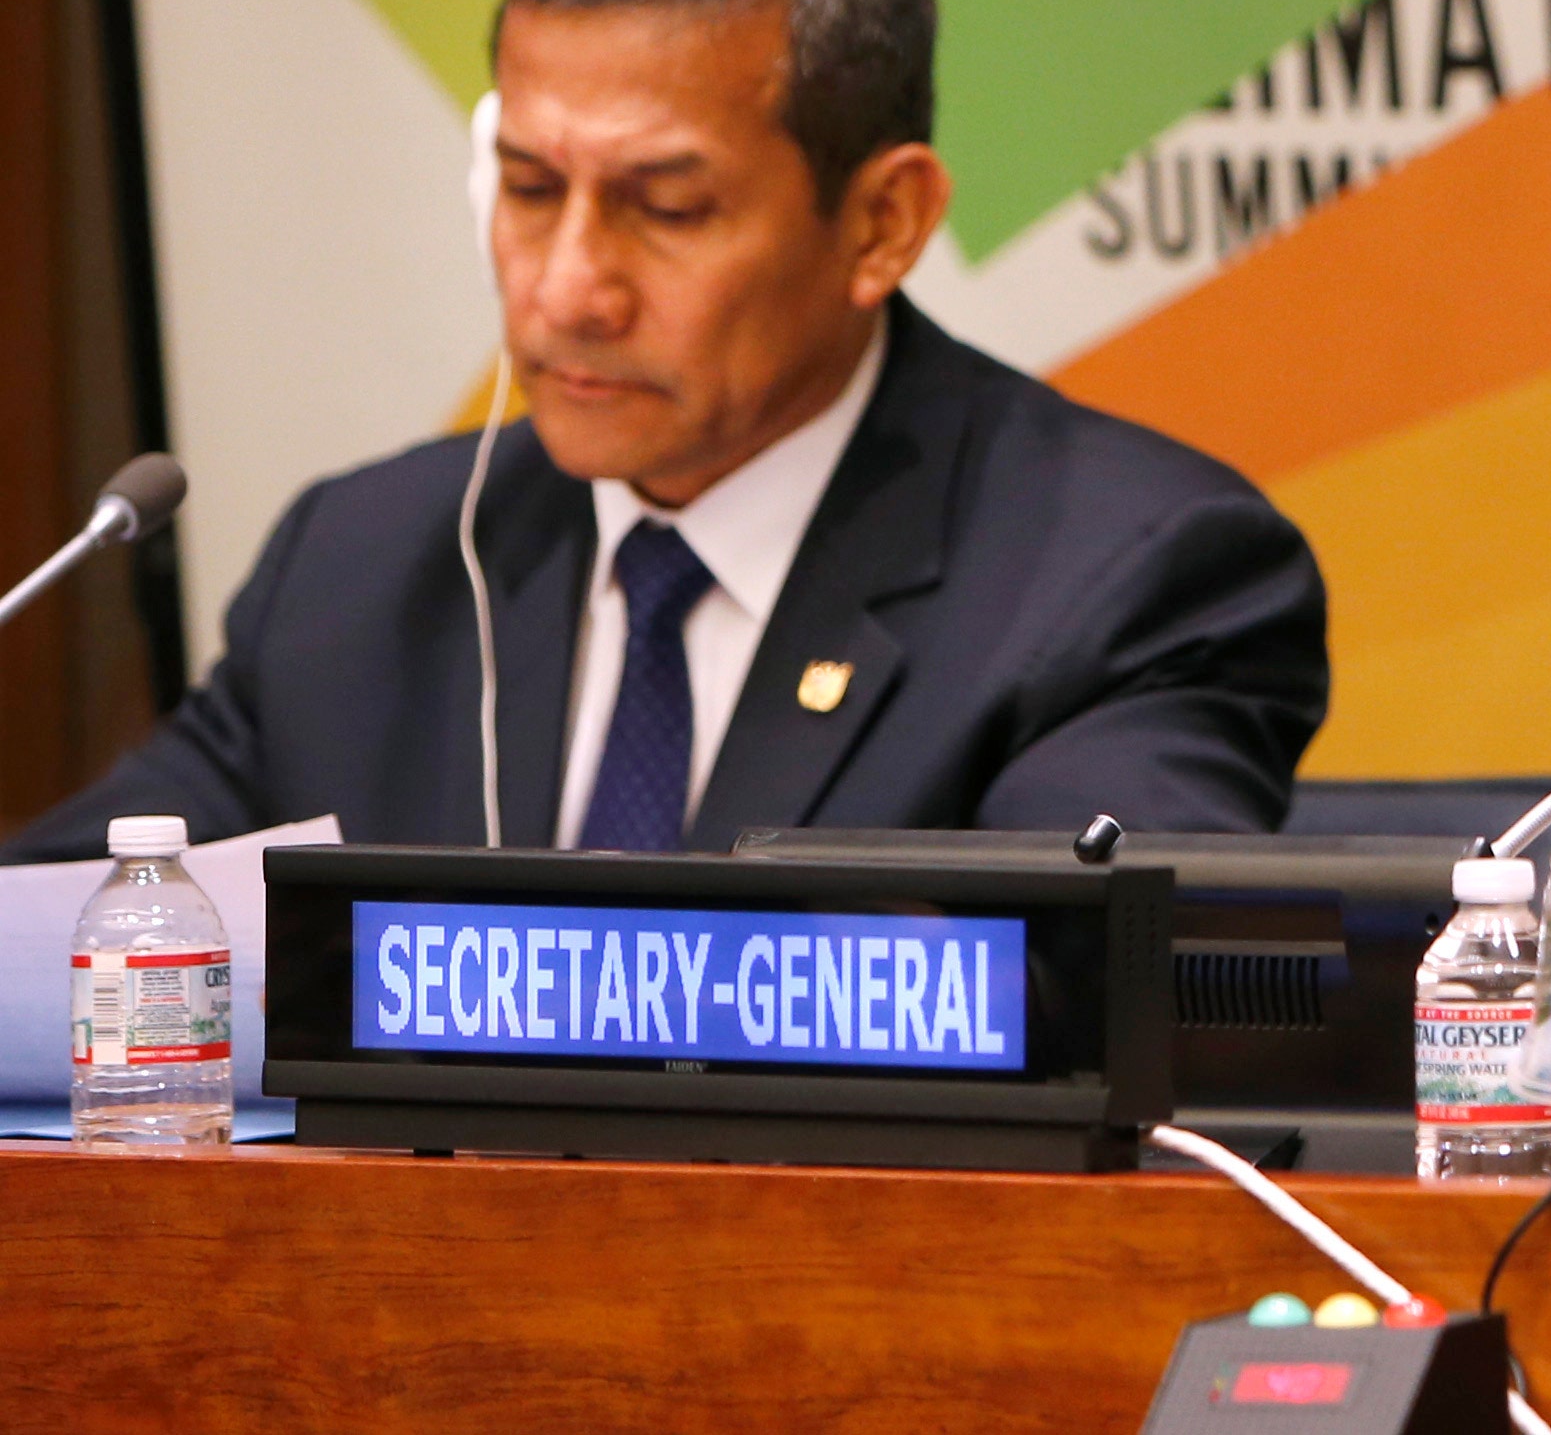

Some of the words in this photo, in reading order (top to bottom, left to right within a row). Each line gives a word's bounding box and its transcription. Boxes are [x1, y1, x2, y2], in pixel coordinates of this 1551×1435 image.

[377, 924, 1005, 1055] SECRETARY-GENERAL
[1442, 1024, 1527, 1047] GEYSER
[1469, 1064, 1507, 1075] WATE
